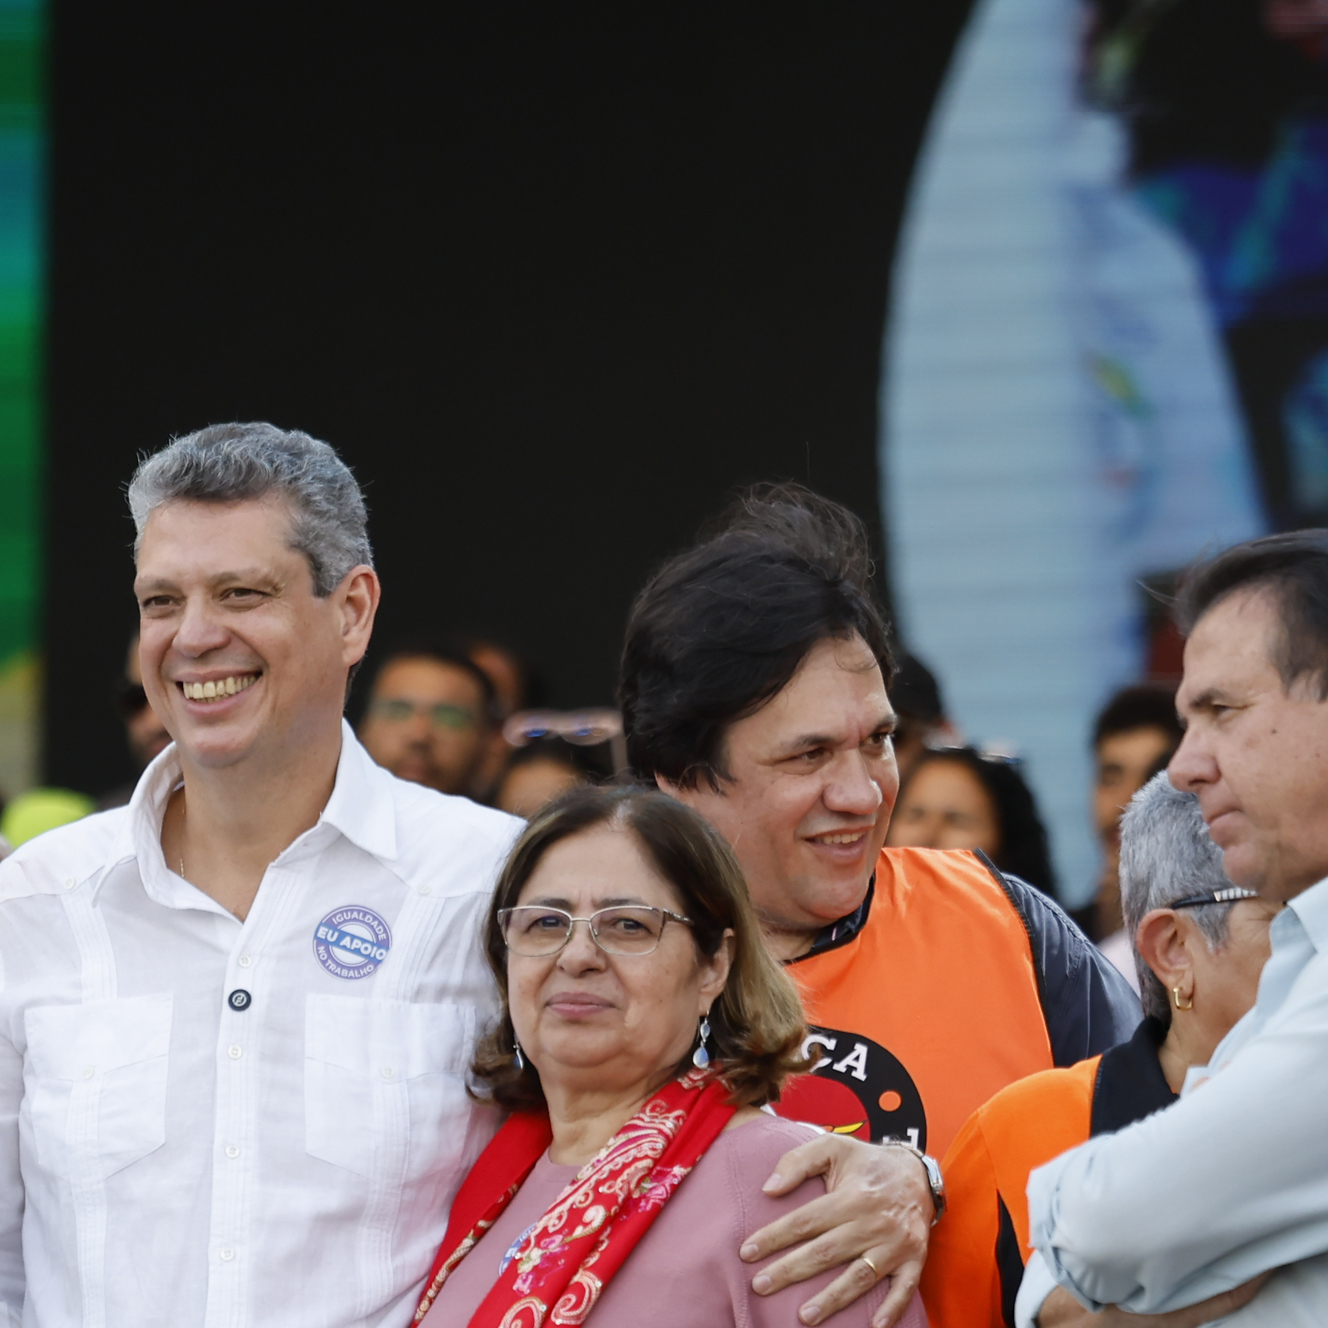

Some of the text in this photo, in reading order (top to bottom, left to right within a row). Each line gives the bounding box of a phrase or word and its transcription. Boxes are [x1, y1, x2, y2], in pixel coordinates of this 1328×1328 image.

[332, 910, 387, 941] IGUALDADE
[316, 926, 387, 961] EU APOIO
[317, 946, 374, 978] NO TRABALHO
